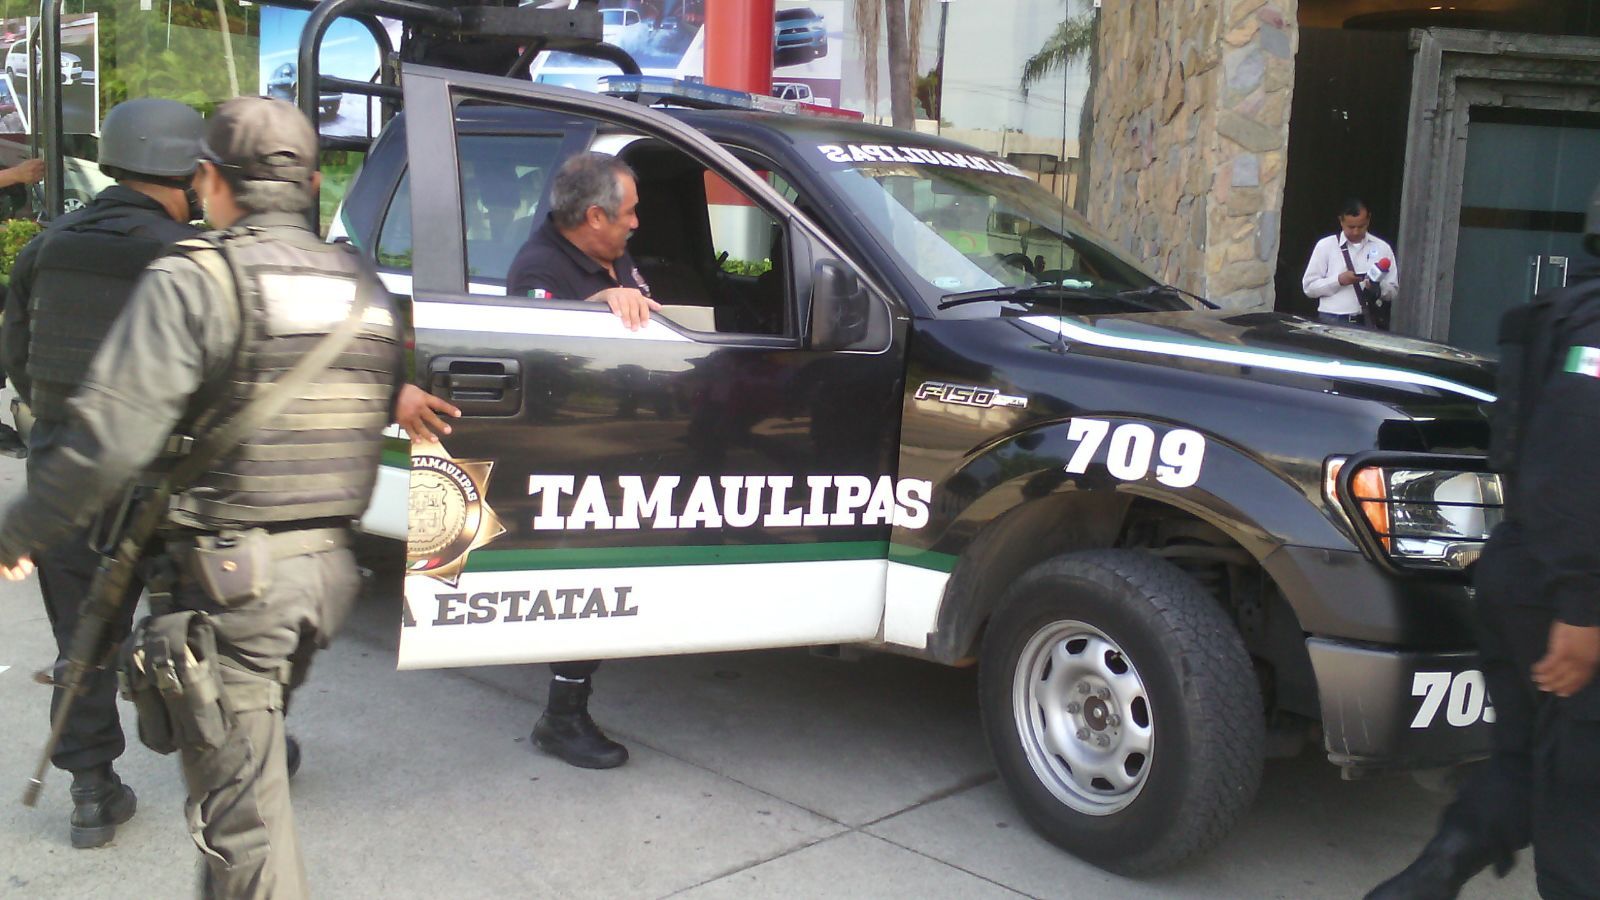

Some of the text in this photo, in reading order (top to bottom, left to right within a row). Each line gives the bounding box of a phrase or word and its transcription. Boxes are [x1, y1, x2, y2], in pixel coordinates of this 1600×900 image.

[411, 457, 478, 502] TAMAULIPAS
[1063, 417, 1206, 488] 709
[528, 474, 932, 530] TAMAULIPAS
[432, 586, 638, 626] ESTATAL
[1410, 670, 1497, 728] 70
